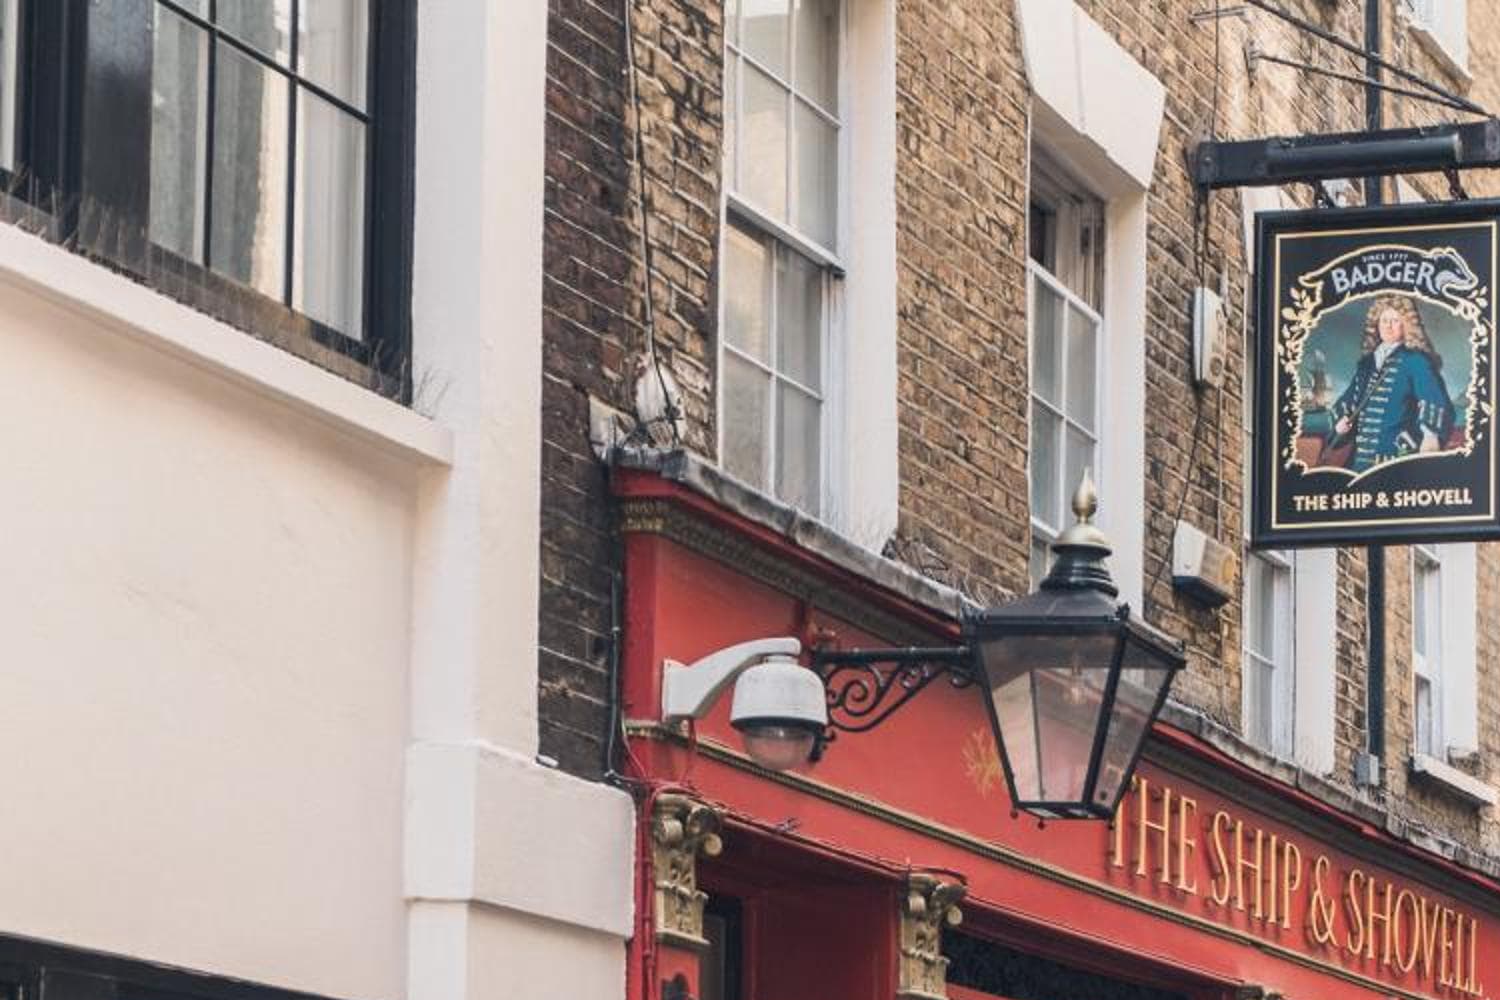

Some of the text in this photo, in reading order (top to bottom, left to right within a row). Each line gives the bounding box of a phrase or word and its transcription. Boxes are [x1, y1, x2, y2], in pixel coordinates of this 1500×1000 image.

[1331, 261, 1439, 294] BADGER
[1292, 487, 1472, 511] THE SHIP & SHOVELL
[1211, 810, 1302, 930] SHIP
[1311, 855, 1339, 947] &
[1347, 869, 1484, 998] SHOVELL
